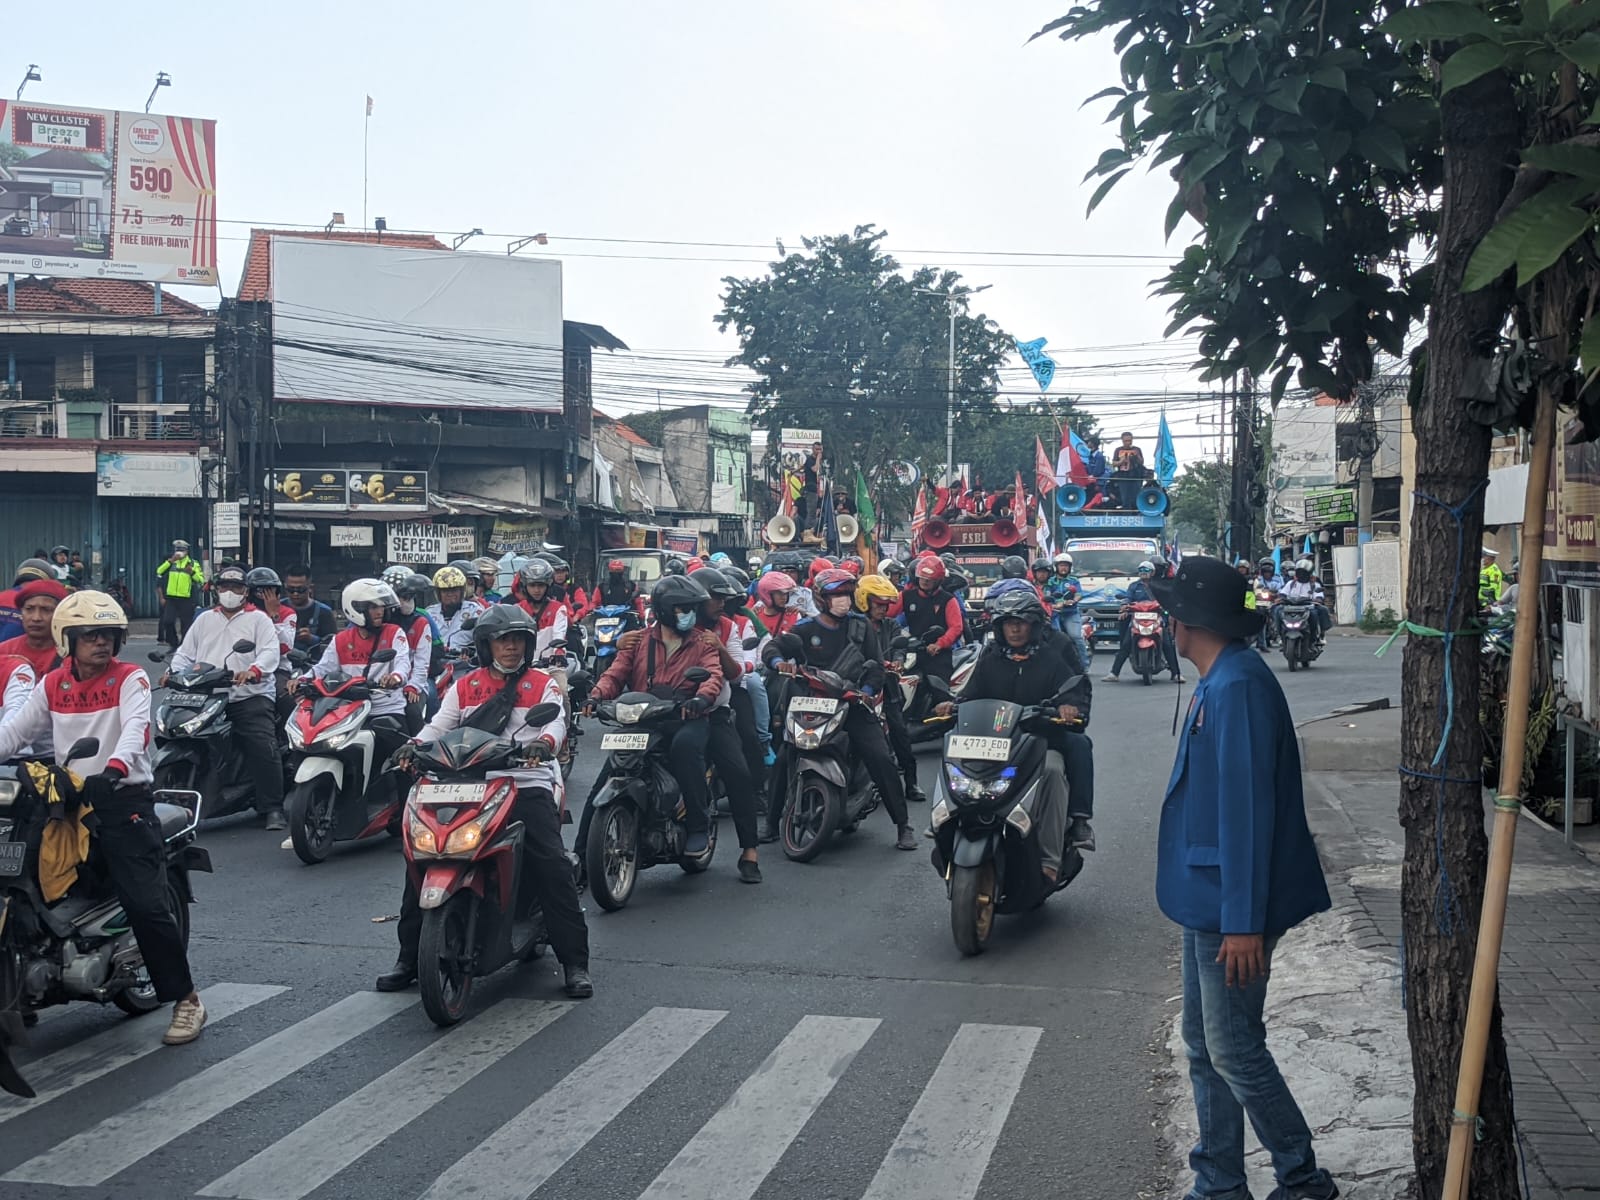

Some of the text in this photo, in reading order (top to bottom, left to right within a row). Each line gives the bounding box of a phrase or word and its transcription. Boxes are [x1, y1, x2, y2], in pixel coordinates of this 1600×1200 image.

[26, 112, 91, 126] NEW CLUSTER
[38, 125, 80, 138] Breeze
[122, 208, 143, 225] 7.5
[170, 214, 184, 227] 20
[120, 234, 139, 245] FREE
[187, 268, 210, 276] JAYA
[1084, 515, 1144, 527] SP LEM SPSI
[388, 521, 448, 538] PARKIRAN
[336, 533, 364, 541] TAMBAL
[392, 537, 441, 553] SEPEDA
[395, 553, 437, 564] BAROKAH
[613, 735, 632, 743] 4407
[632, 735, 646, 743] NEL
[951, 737, 958, 746] N
[963, 738, 987, 748] 4773
[419, 786, 425, 794] L
[433, 785, 461, 794] 5414
